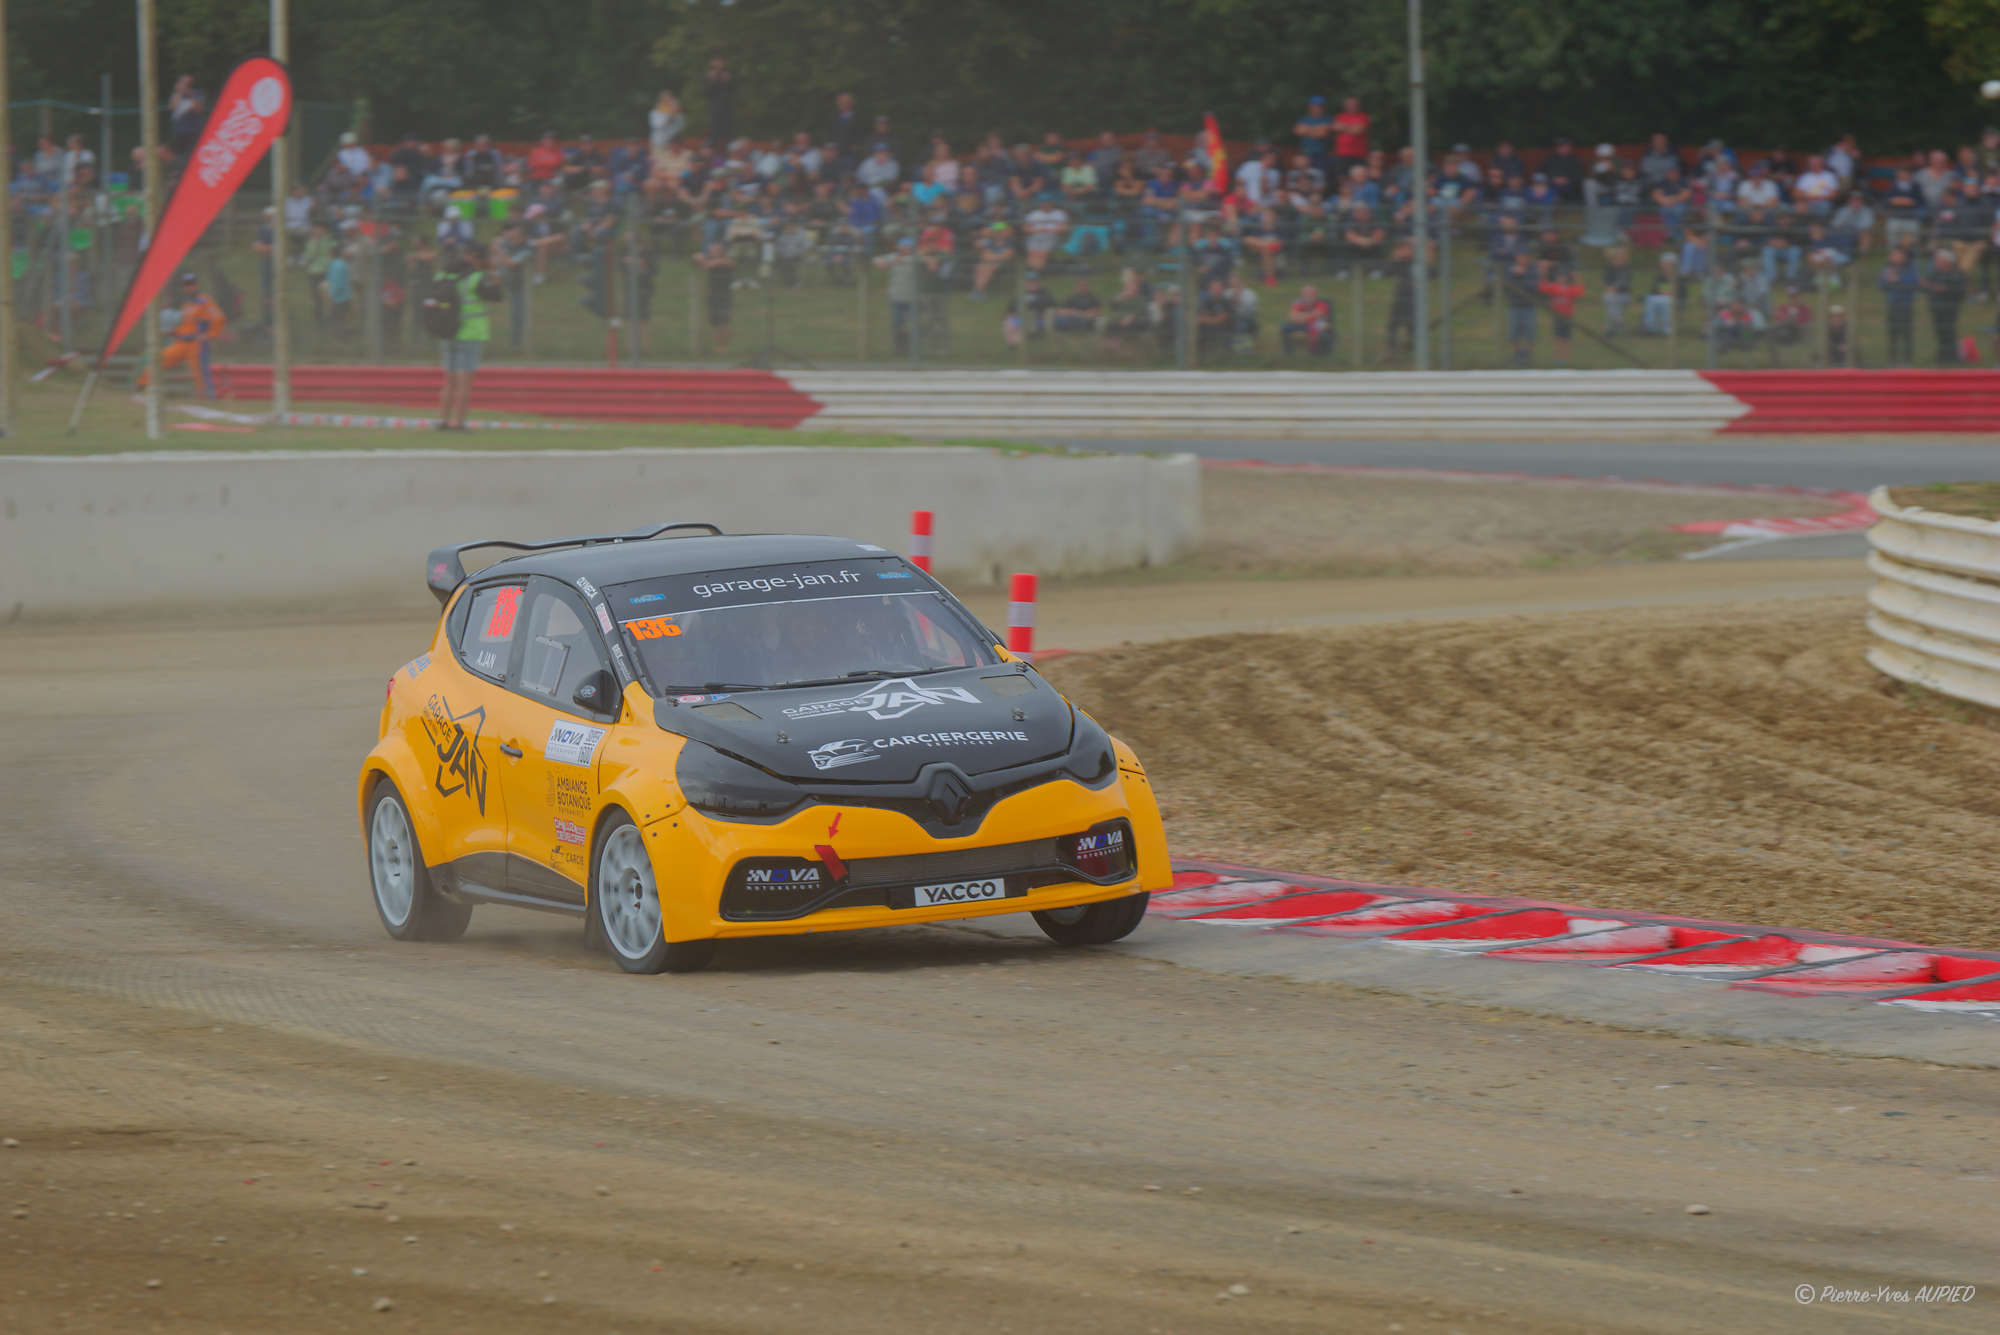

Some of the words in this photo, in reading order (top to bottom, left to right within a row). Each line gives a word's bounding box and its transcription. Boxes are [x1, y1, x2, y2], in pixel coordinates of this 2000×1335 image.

[692, 570, 862, 598] garage-jan.fr
[487, 587, 523, 637] 136
[625, 617, 682, 641] 136
[782, 698, 869, 715] GARAGE
[848, 686, 983, 712] JAN
[872, 731, 1029, 748] CARCIERGERIE
[556, 776, 589, 794] AMBIANCE
[923, 881, 996, 903] YACCO
